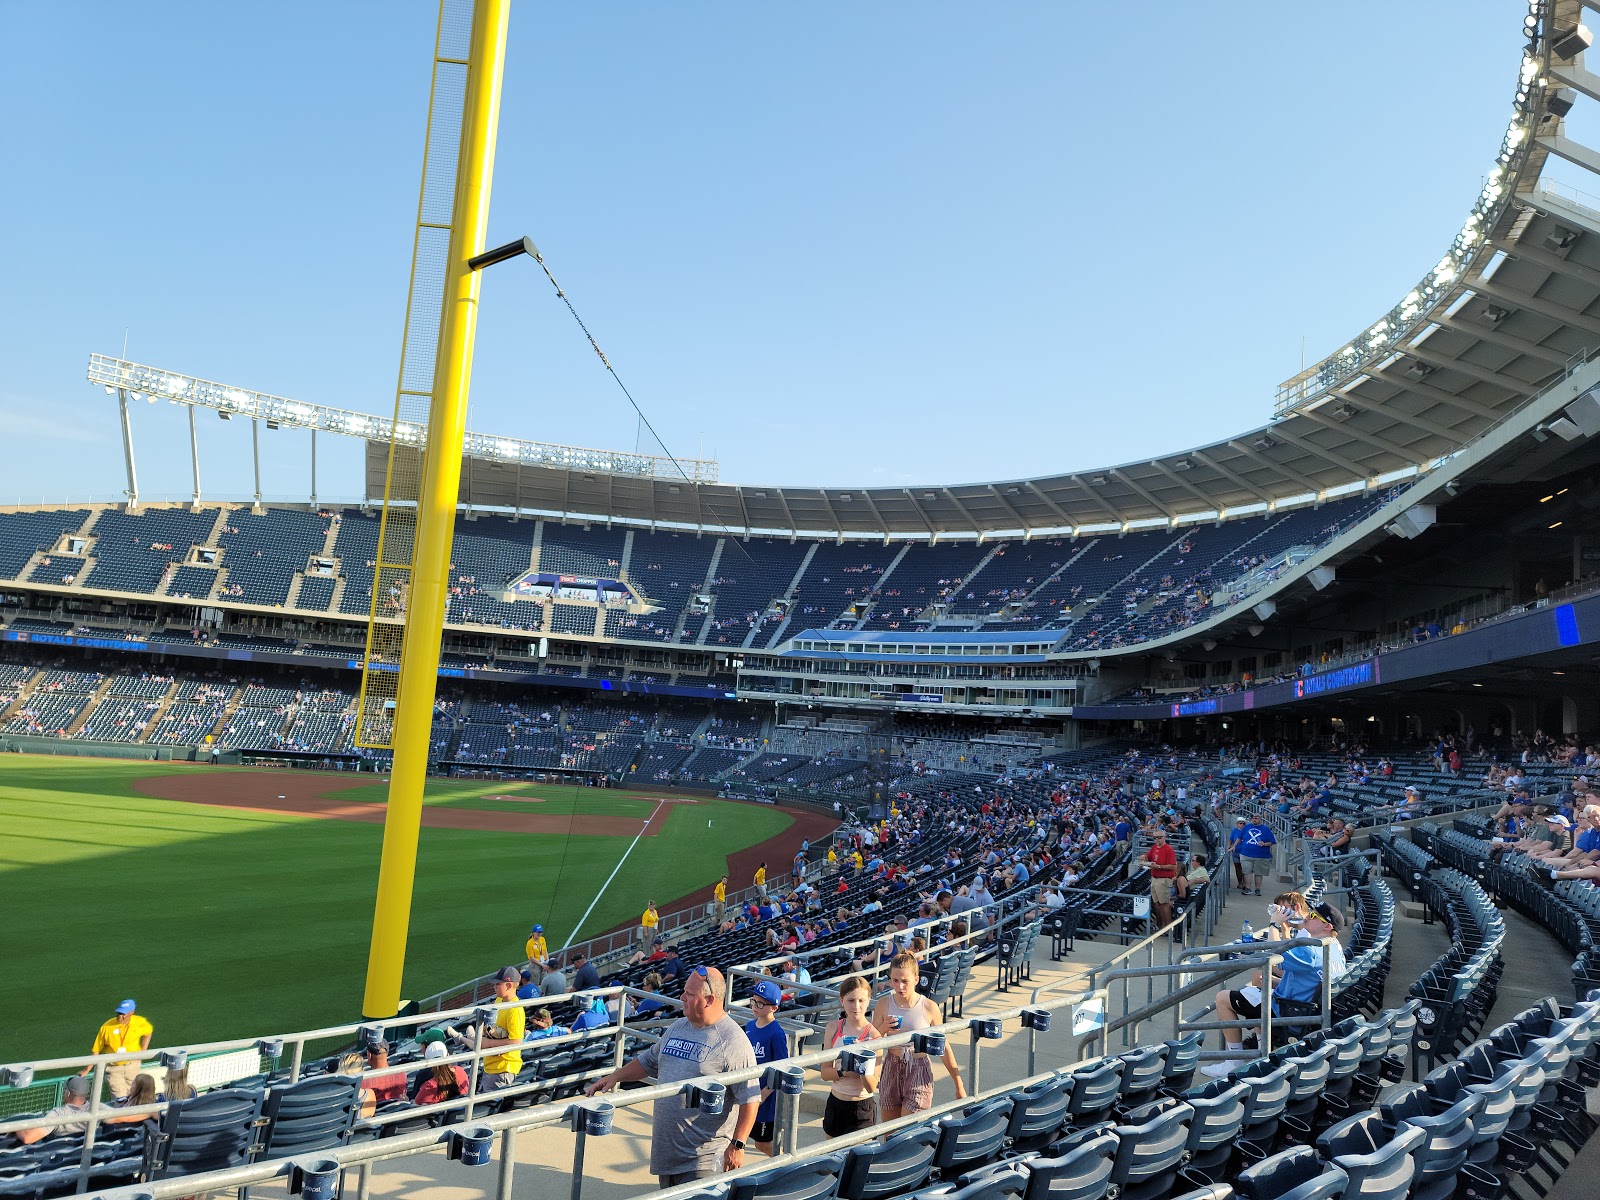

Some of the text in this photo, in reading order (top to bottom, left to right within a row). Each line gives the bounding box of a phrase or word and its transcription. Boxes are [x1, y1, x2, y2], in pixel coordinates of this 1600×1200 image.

[31, 633, 73, 645] ROYALS
[76, 638, 148, 650] COUNTDOWN
[1304, 674, 1326, 694] ROYALS
[1326, 662, 1372, 689] COUNTDOWN
[666, 1039, 695, 1051] KANSAS CITY
[364, 1074, 401, 1088] BOSTON
